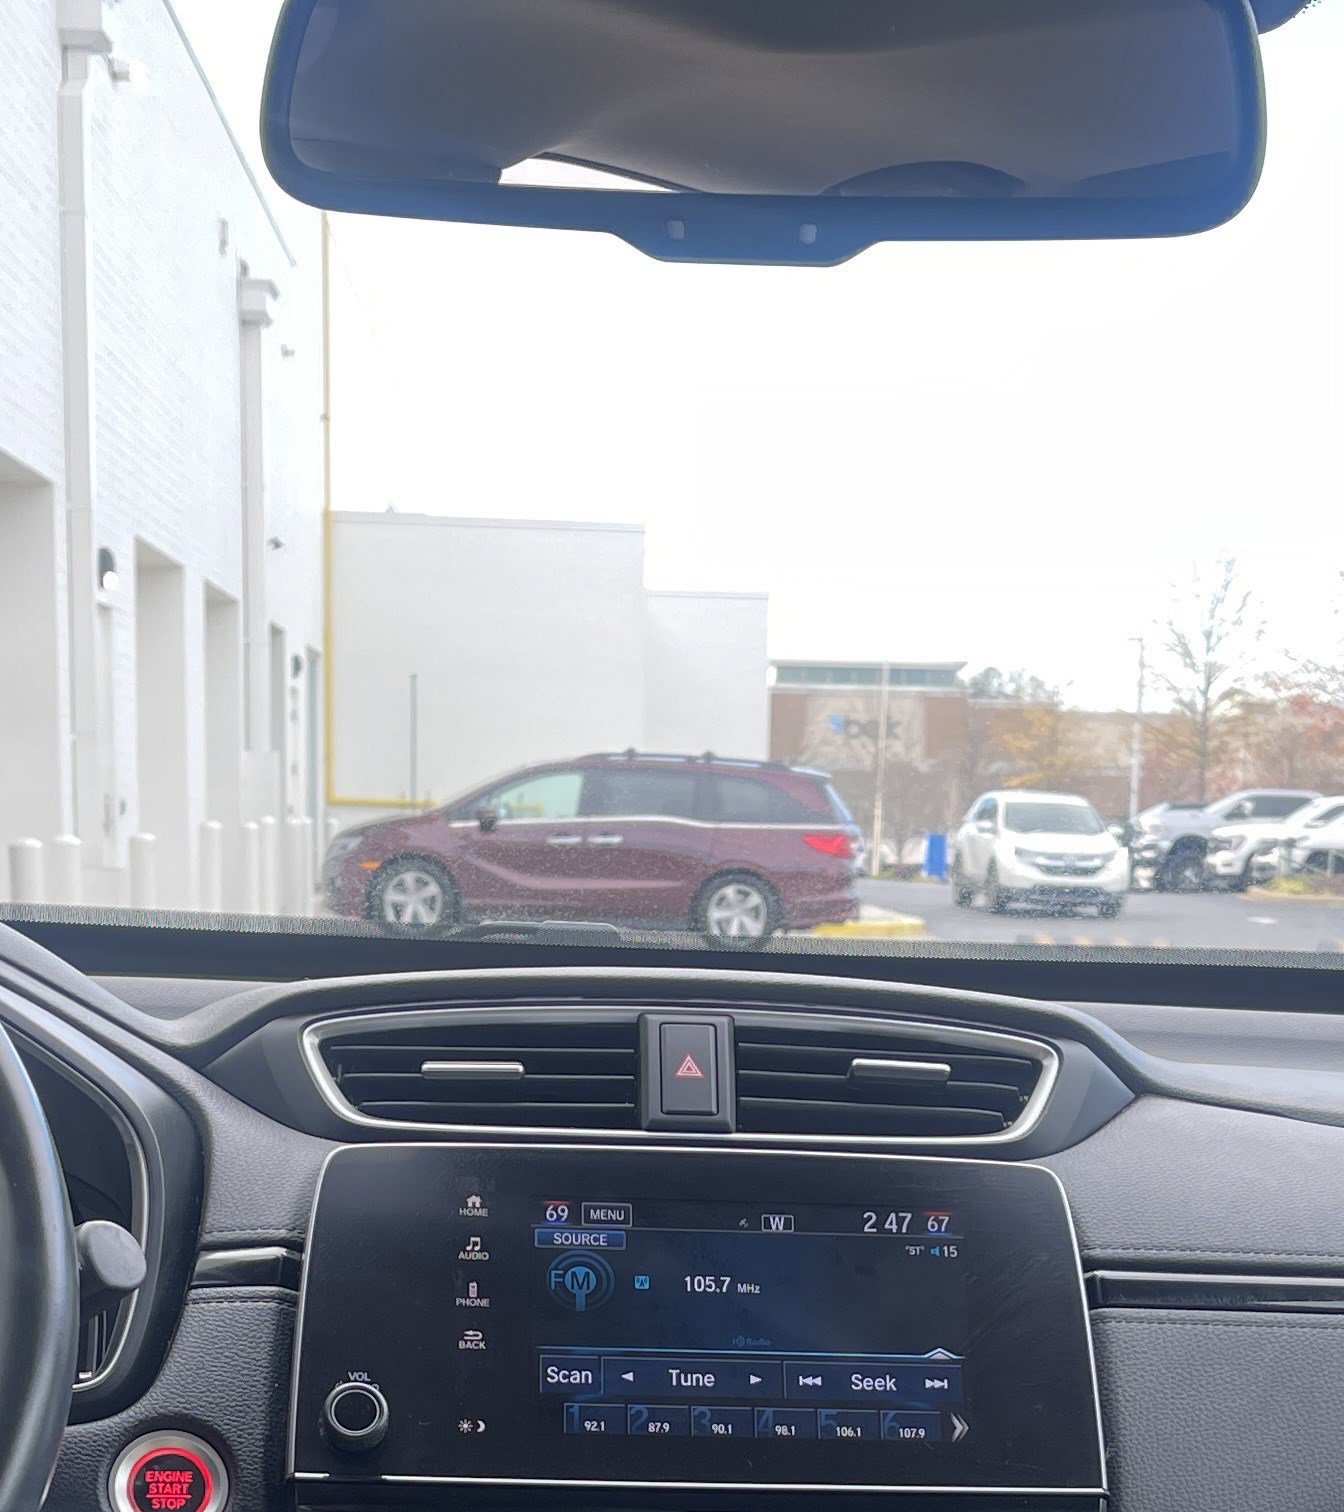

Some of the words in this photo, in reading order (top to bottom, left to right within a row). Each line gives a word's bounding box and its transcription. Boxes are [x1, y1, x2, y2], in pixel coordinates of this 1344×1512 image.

[458, 1207, 489, 1217] HOME
[545, 1204, 570, 1223] 69
[589, 1207, 626, 1222] MENU
[769, 1216, 785, 1231] W
[927, 1216, 950, 1232] 67
[552, 1232, 608, 1247] SOURCE
[458, 1251, 489, 1261] AUDIO
[942, 1245, 958, 1258] 15
[683, 1275, 732, 1294] 105.7
[737, 1282, 761, 1295] MHz
[455, 1297, 490, 1308] PHONE
[458, 1339, 487, 1350] BACK
[347, 1371, 372, 1382] VOL
[546, 1366, 593, 1385] Scan
[668, 1368, 716, 1388] Tune
[850, 1373, 898, 1392] Seek
[583, 1420, 606, 1433] 92.1
[647, 1421, 671, 1434] 87.9
[711, 1422, 734, 1435] 90.1
[774, 1424, 797, 1437] 98.1
[835, 1425, 863, 1438] 106.1
[898, 1427, 927, 1439] 107.9
[144, 1470, 194, 1483] ENGINE
[148, 1482, 190, 1495] START
[151, 1498, 186, 1510] STOP
